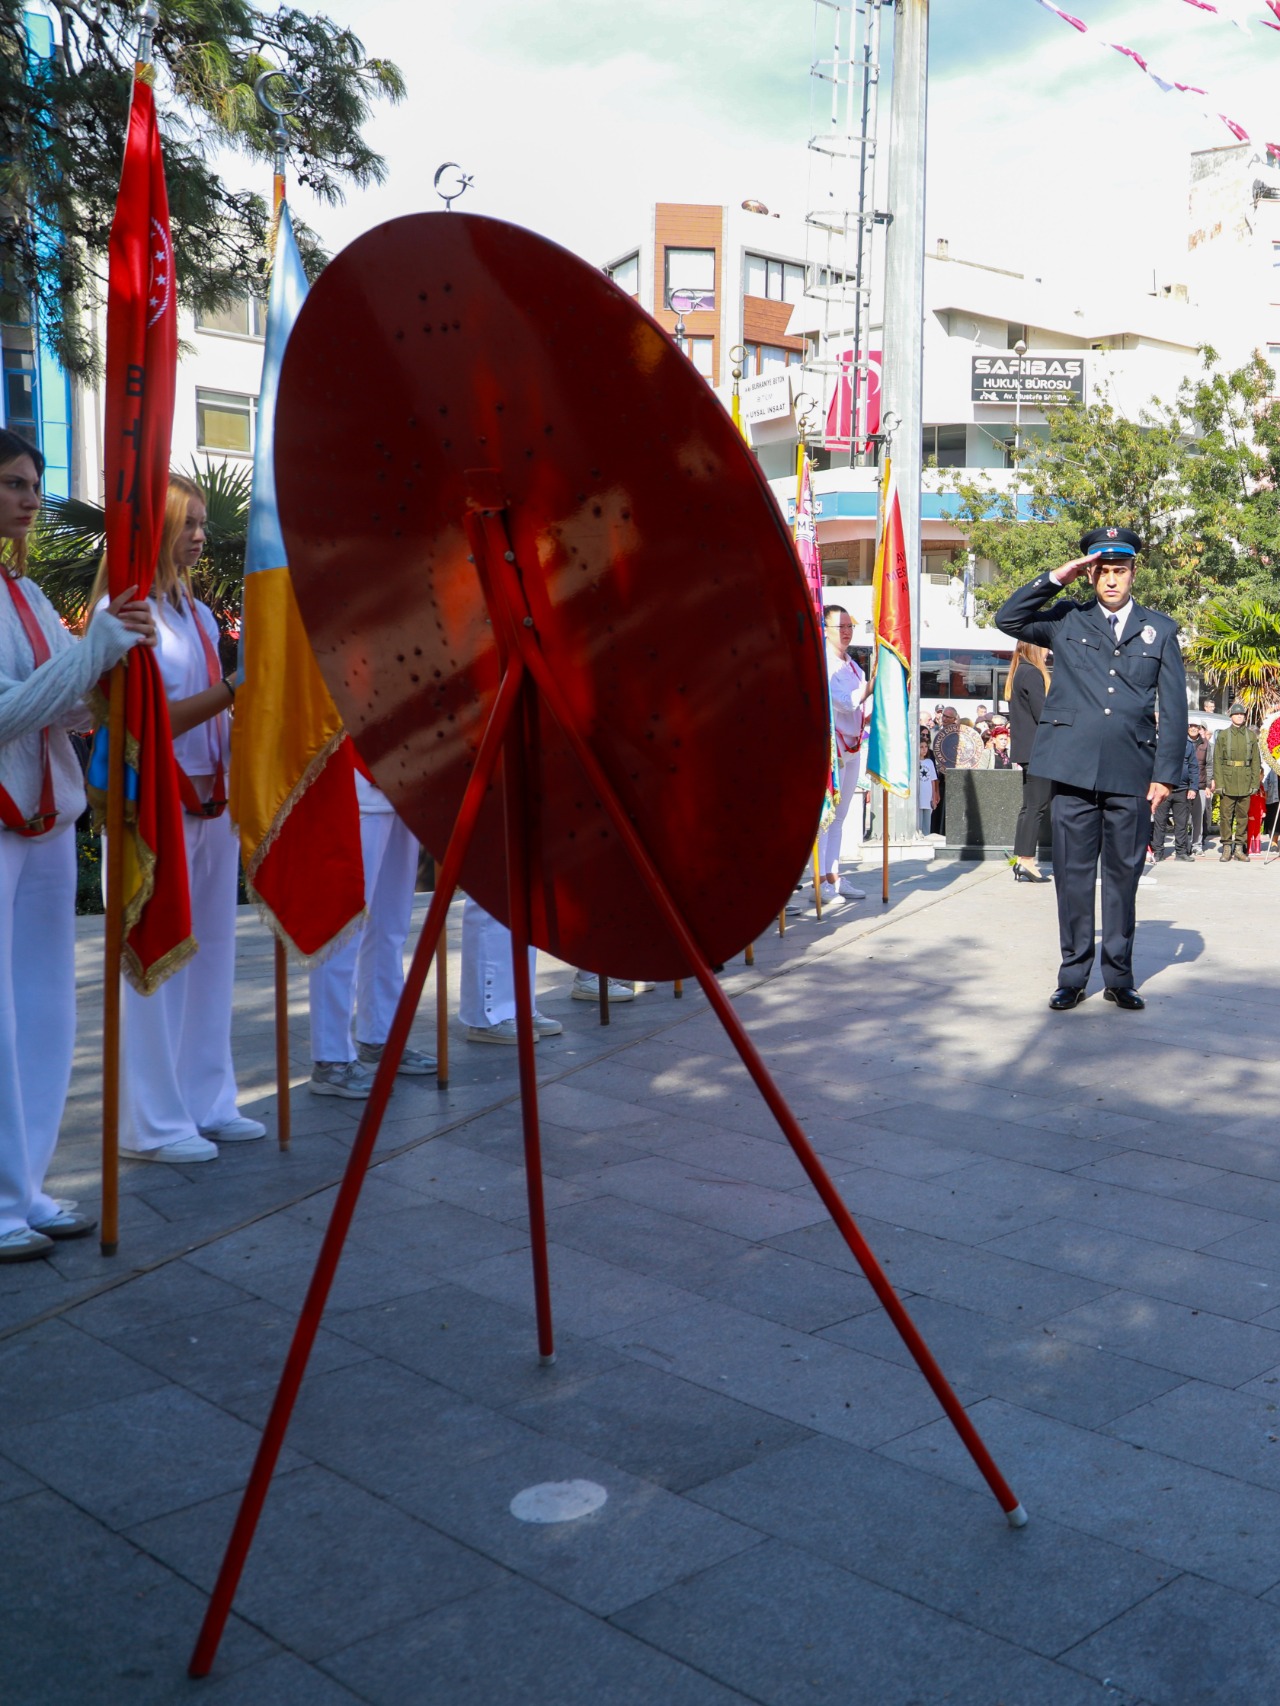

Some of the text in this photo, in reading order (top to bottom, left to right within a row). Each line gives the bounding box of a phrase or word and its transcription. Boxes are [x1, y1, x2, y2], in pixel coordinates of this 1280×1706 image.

[974, 359, 1081, 379] SARIBAŞ
[983, 377, 1072, 390] HUKUK BÜROSU
